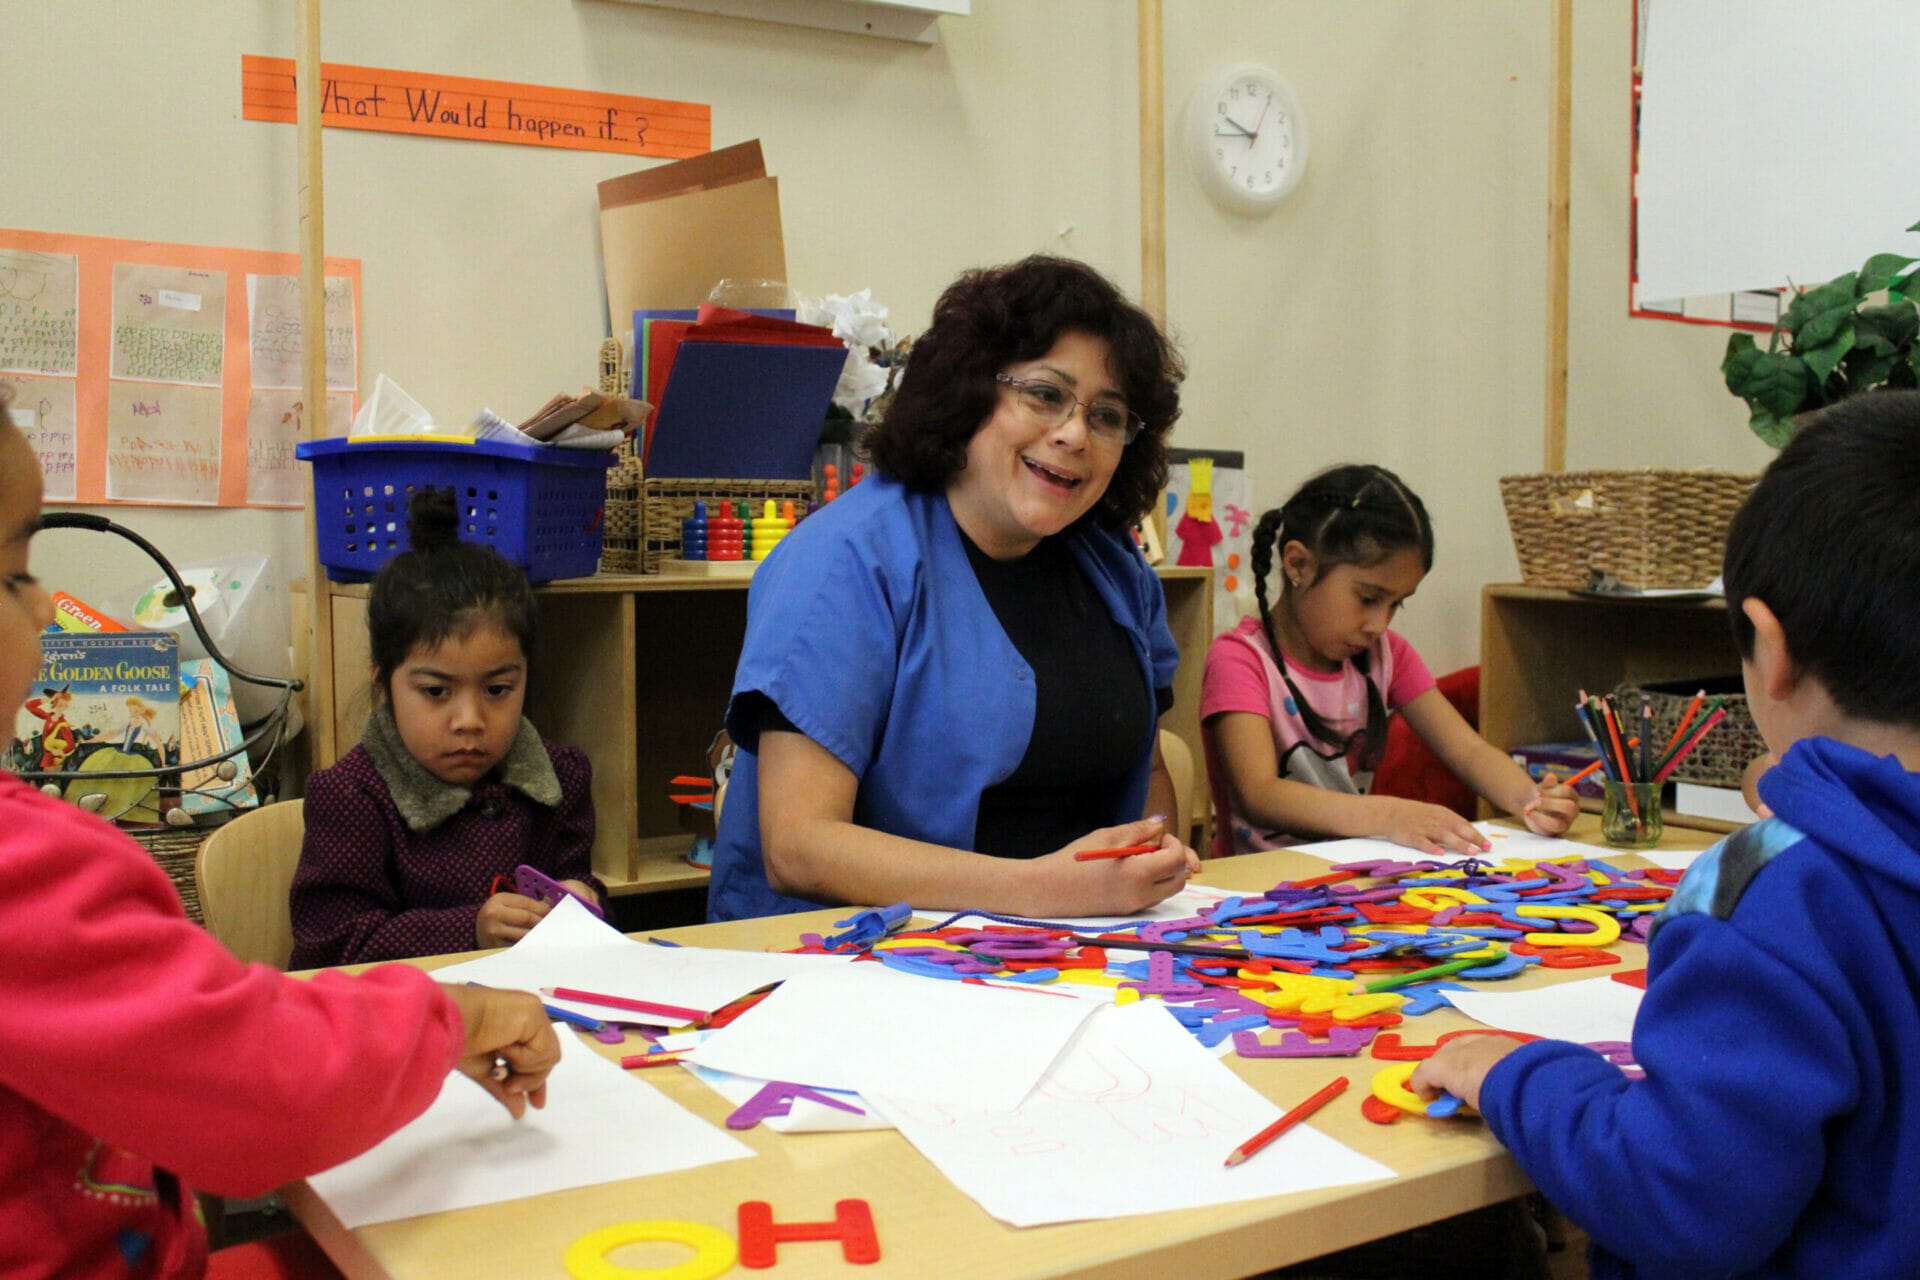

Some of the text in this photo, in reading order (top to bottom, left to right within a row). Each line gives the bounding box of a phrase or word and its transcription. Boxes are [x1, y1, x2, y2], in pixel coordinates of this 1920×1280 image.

[405, 87, 487, 128] Would
[508, 99, 586, 141] happen
[56, 597, 103, 631] Green
[49, 663, 114, 681] GOLDEN
[116, 662, 171, 681] GOOSE
[100, 683, 171, 693] A FOLK TALE
